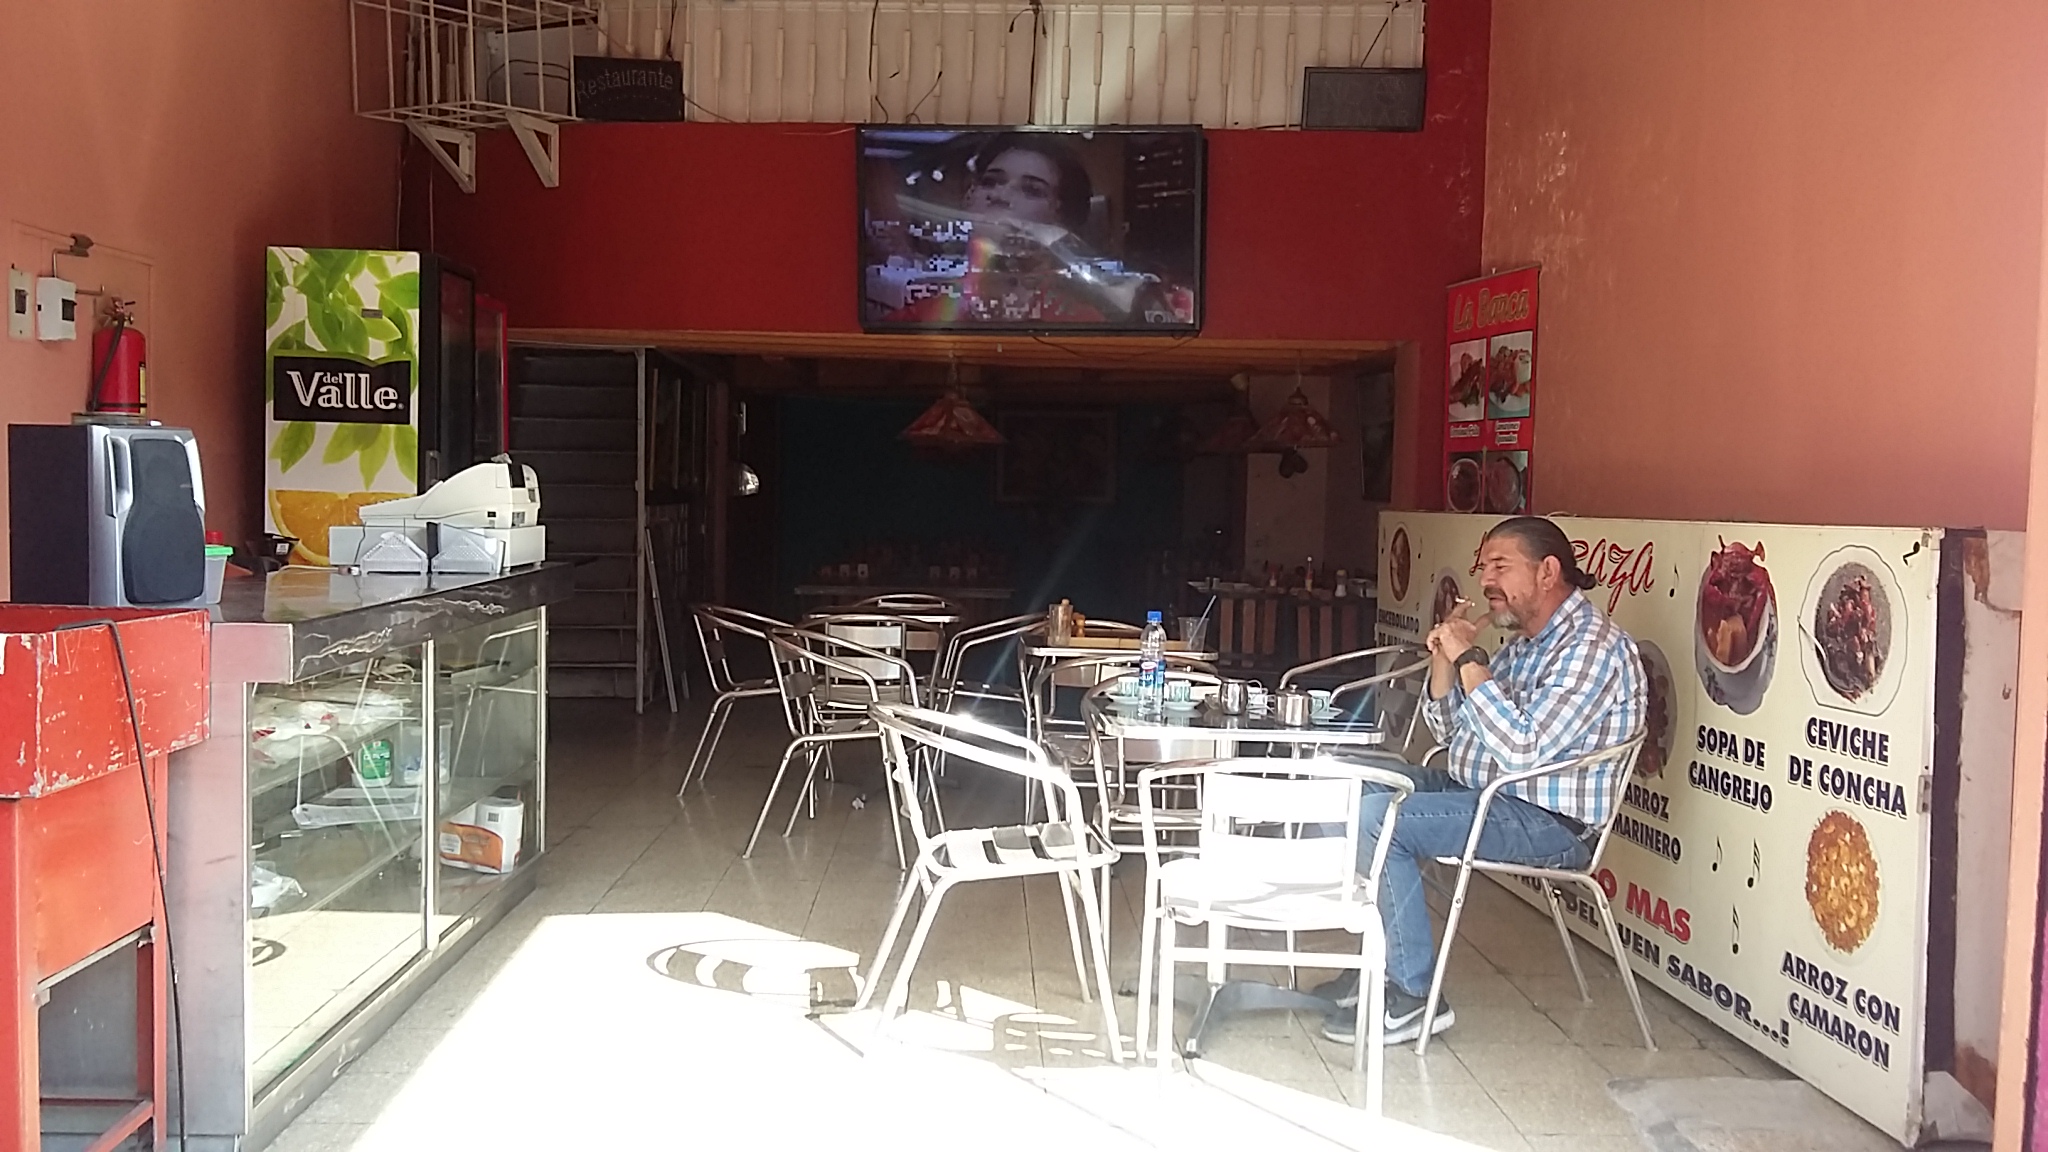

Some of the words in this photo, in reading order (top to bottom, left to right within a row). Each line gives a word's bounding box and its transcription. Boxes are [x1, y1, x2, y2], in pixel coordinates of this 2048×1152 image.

[577, 67, 674, 102] Restaurante
[322, 372, 344, 384] del
[1697, 724, 1739, 761] SOPA
[1743, 737, 1766, 769] DE
[1805, 716, 1890, 764] CEVICHE
[1624, 782, 1669, 821] ARROZ
[1688, 760, 1773, 812] CANGREJO
[1789, 754, 1813, 788] DE
[1818, 764, 1908, 818] CONCHA
[1612, 813, 1681, 863] MARINERO
[1626, 882, 1691, 944] MAS
[1617, 922, 1661, 967] UEN
[1781, 951, 1849, 1005] ARROZ
[1854, 988, 1901, 1035] CON
[1787, 992, 1890, 1070] CAMARON
